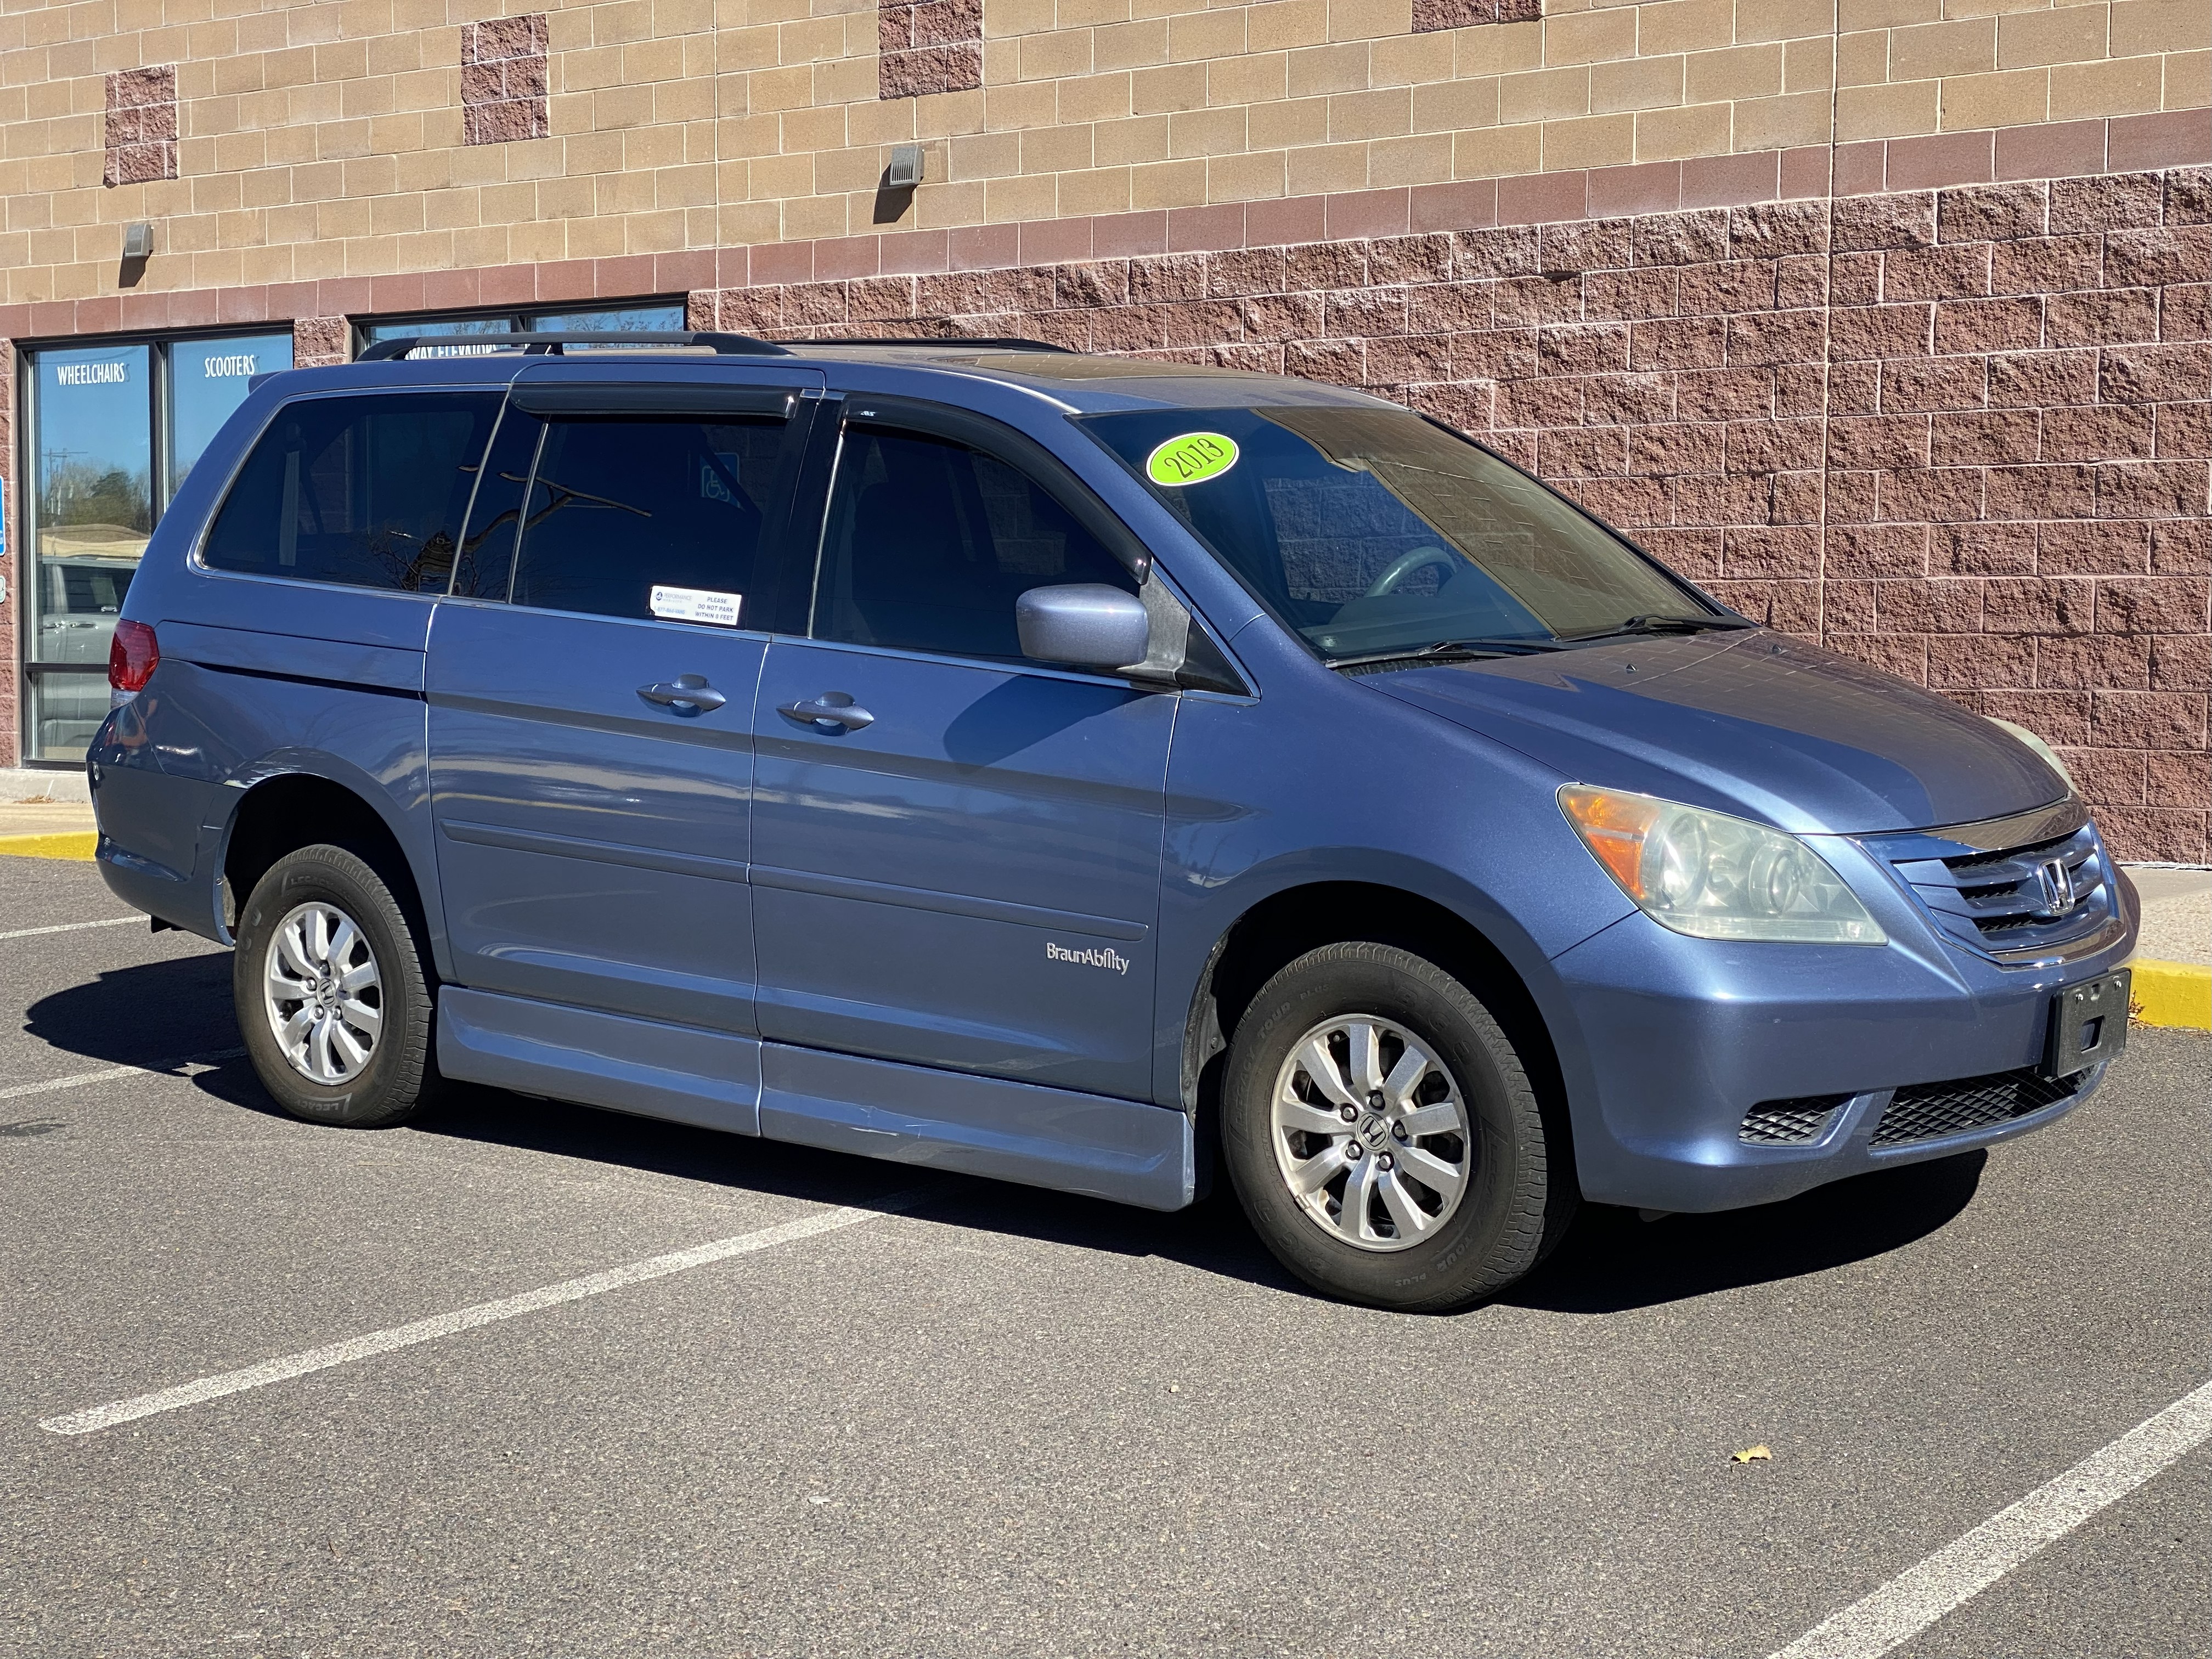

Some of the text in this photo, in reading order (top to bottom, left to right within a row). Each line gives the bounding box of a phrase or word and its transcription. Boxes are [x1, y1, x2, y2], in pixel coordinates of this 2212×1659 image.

[58, 363, 125, 385] WHEELCHAIRS
[205, 355, 255, 377] SCOOTERS
[1164, 438, 1224, 478] 2013
[1046, 942, 1130, 975] BraunAbility
[1256, 1001, 1291, 1040] TOUR
[1299, 984, 1330, 1000] PLUS
[1435, 1234, 1474, 1272] TOUR
[1395, 1272, 1426, 1287] PLUS
